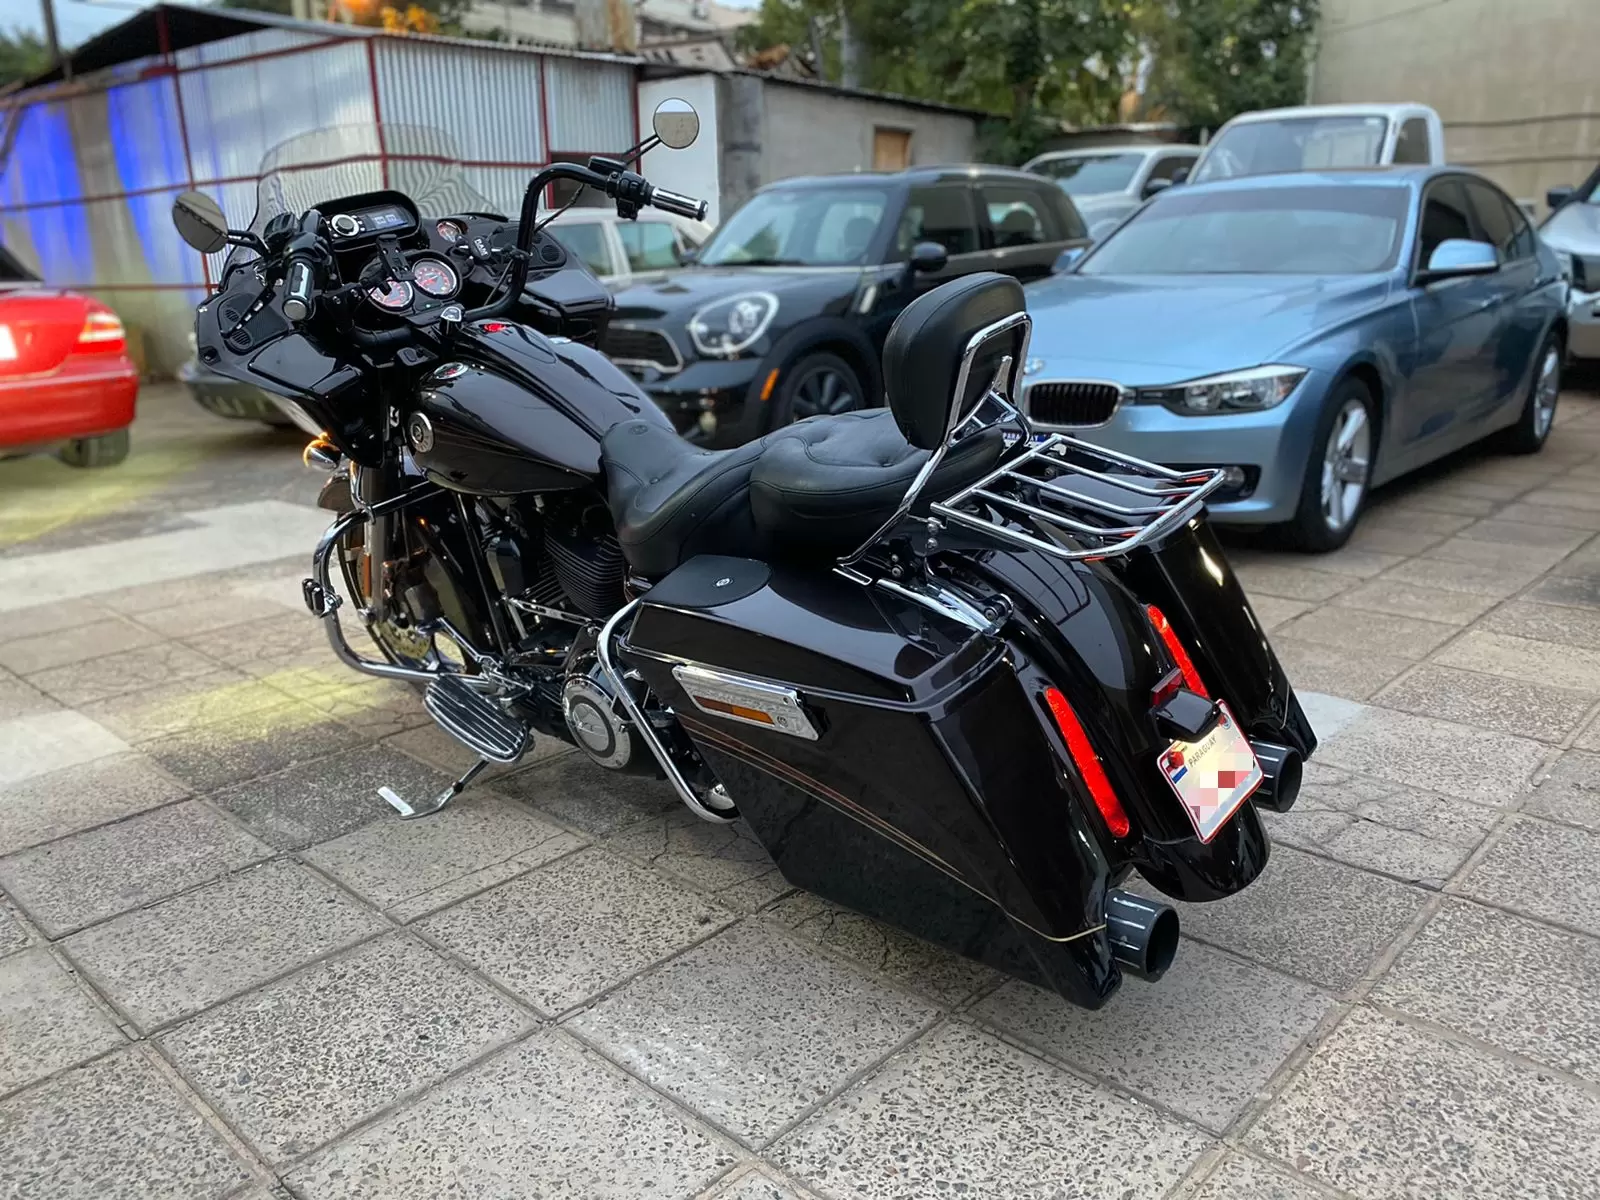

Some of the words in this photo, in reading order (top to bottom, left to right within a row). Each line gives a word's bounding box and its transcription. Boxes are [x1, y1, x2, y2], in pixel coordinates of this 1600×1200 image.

[474, 239, 488, 256] RAM
[1002, 432, 1039, 441] PARAAY
[1188, 735, 1217, 768] PARAGUAY
